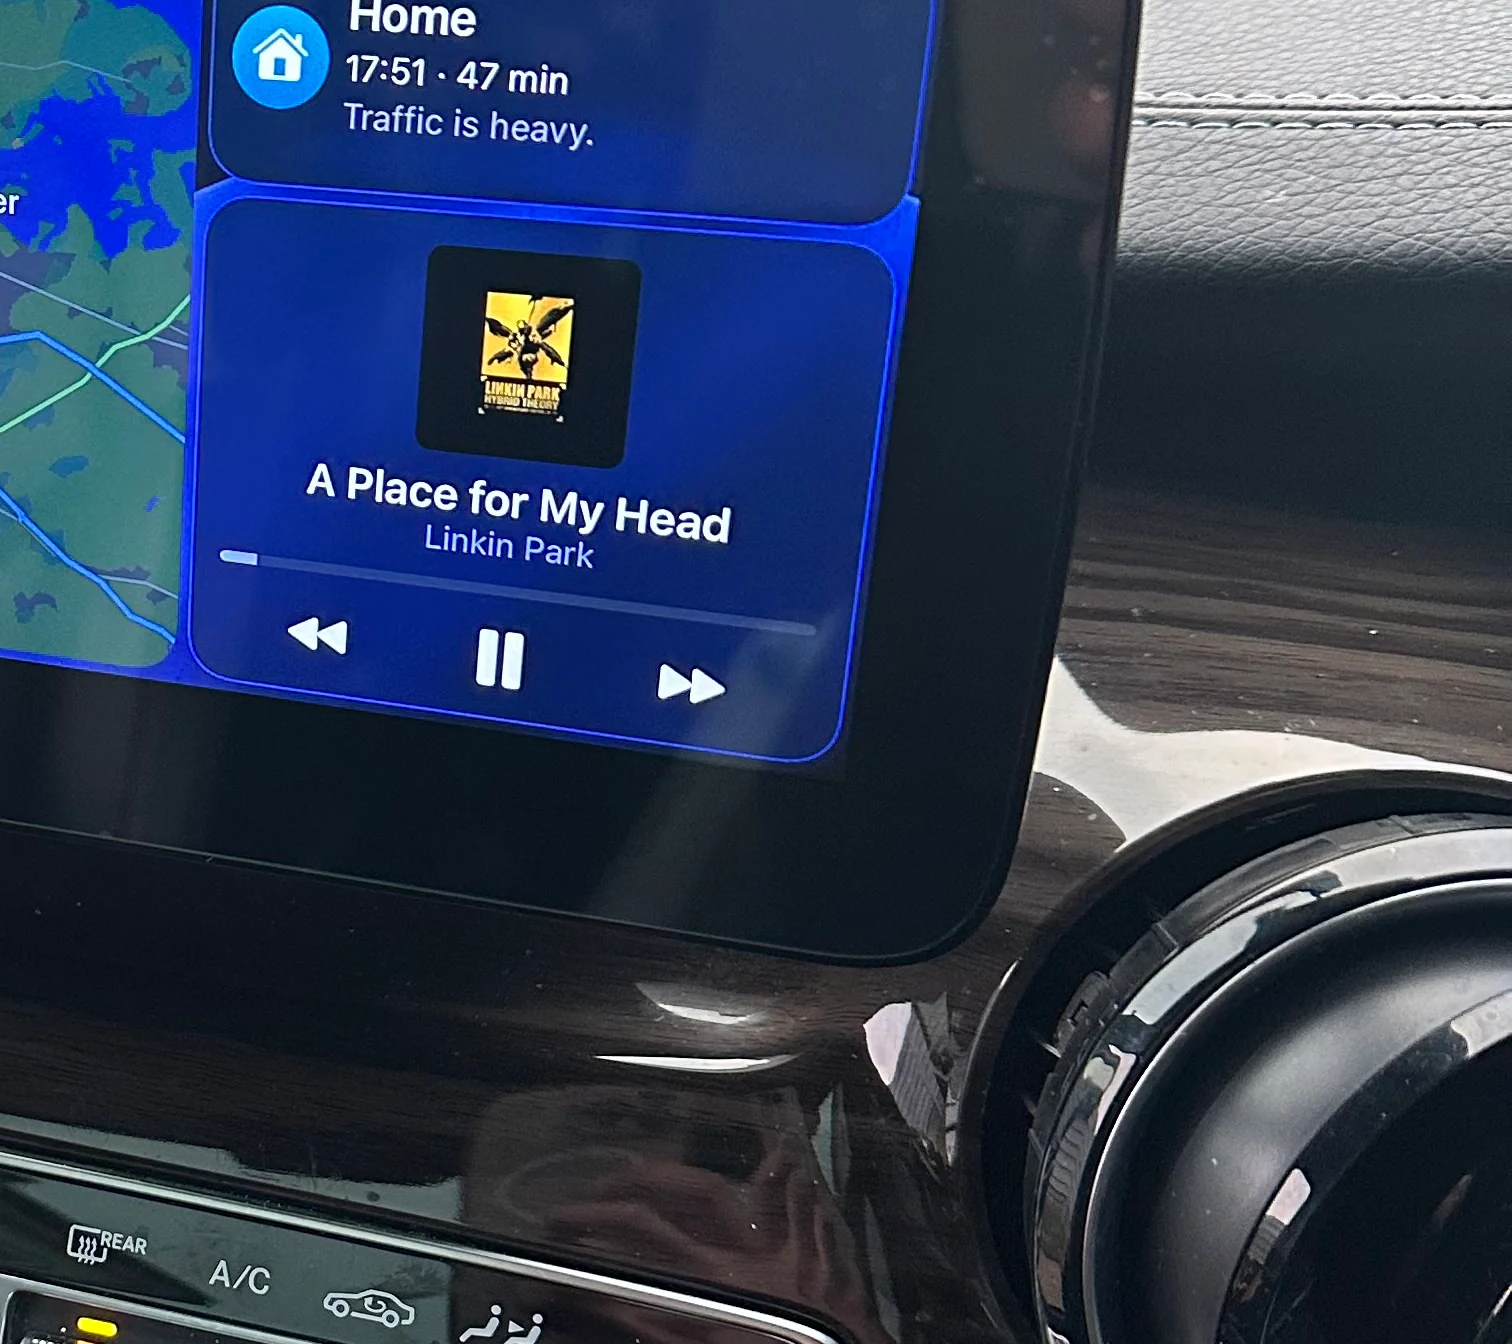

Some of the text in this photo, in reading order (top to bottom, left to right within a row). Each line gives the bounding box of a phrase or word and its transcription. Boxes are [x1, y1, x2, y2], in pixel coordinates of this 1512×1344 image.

[345, 55, 569, 96] 17:51 47 min
[343, 102, 594, 152] Traffic is heavy.
[484, 380, 561, 403] LINKIN PARK
[305, 463, 733, 544] A Place for My Head
[424, 523, 595, 570] Linkin Park
[99, 1229, 148, 1256] REAR
[208, 1260, 272, 1296] A/C
